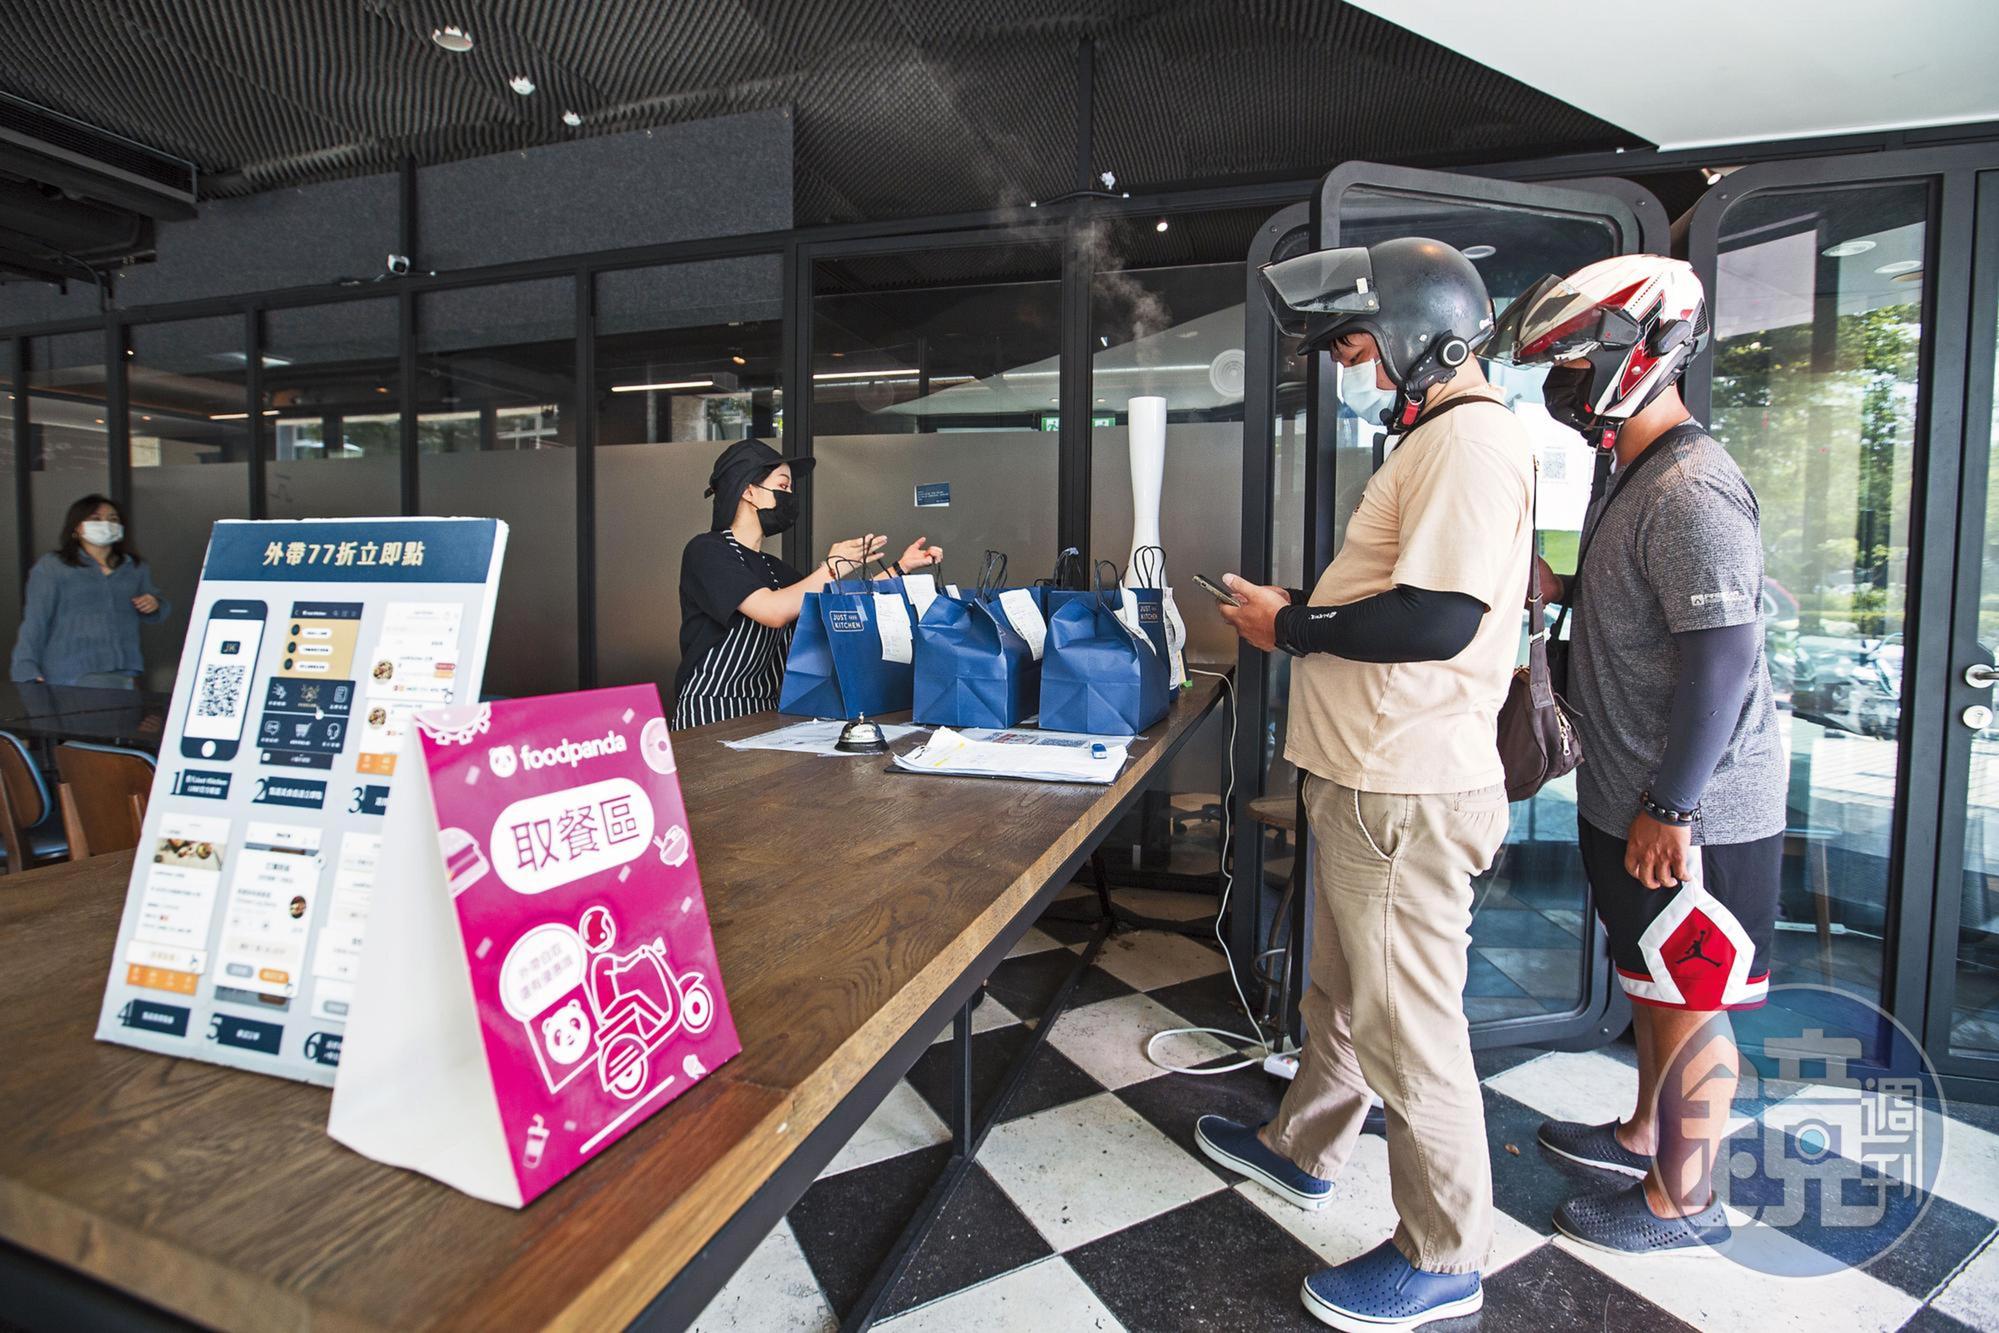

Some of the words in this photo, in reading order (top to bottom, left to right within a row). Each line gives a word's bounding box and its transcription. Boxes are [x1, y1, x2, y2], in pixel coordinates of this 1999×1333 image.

[263, 541, 425, 566] 外帶77折立即點
[834, 621, 861, 629] KITCHEN
[520, 730, 627, 770] foodpanda
[252, 778, 266, 803] 2
[348, 786, 363, 814] 3
[510, 795, 640, 871] 取餐區
[117, 1000, 134, 1027] 4
[206, 1012, 223, 1039] 5
[304, 1031, 320, 1059] 6
